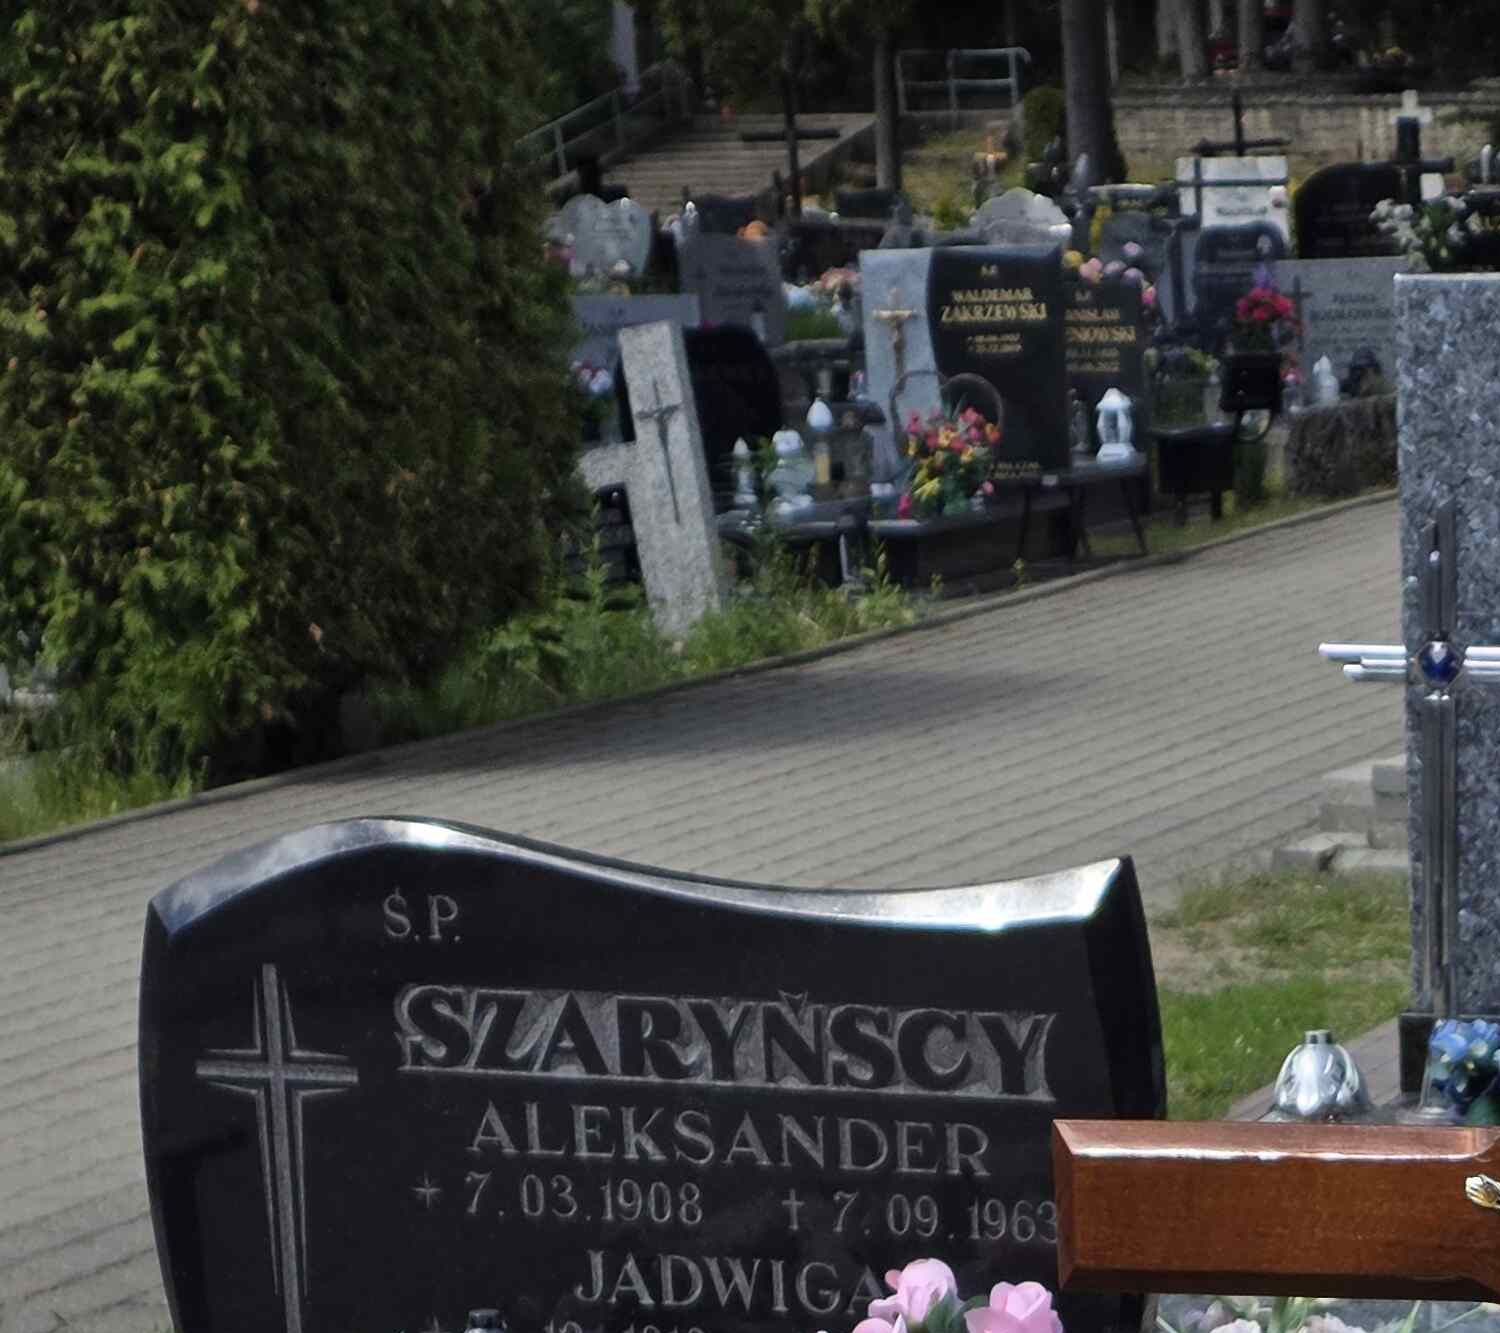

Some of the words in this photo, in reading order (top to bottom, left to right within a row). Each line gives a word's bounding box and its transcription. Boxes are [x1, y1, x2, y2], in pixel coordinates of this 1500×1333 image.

[396, 984, 1057, 1101] SZARYŃSCY
[466, 1101, 991, 1177] ALEKSANDER
[574, 1249, 886, 1315] JADWIGA
